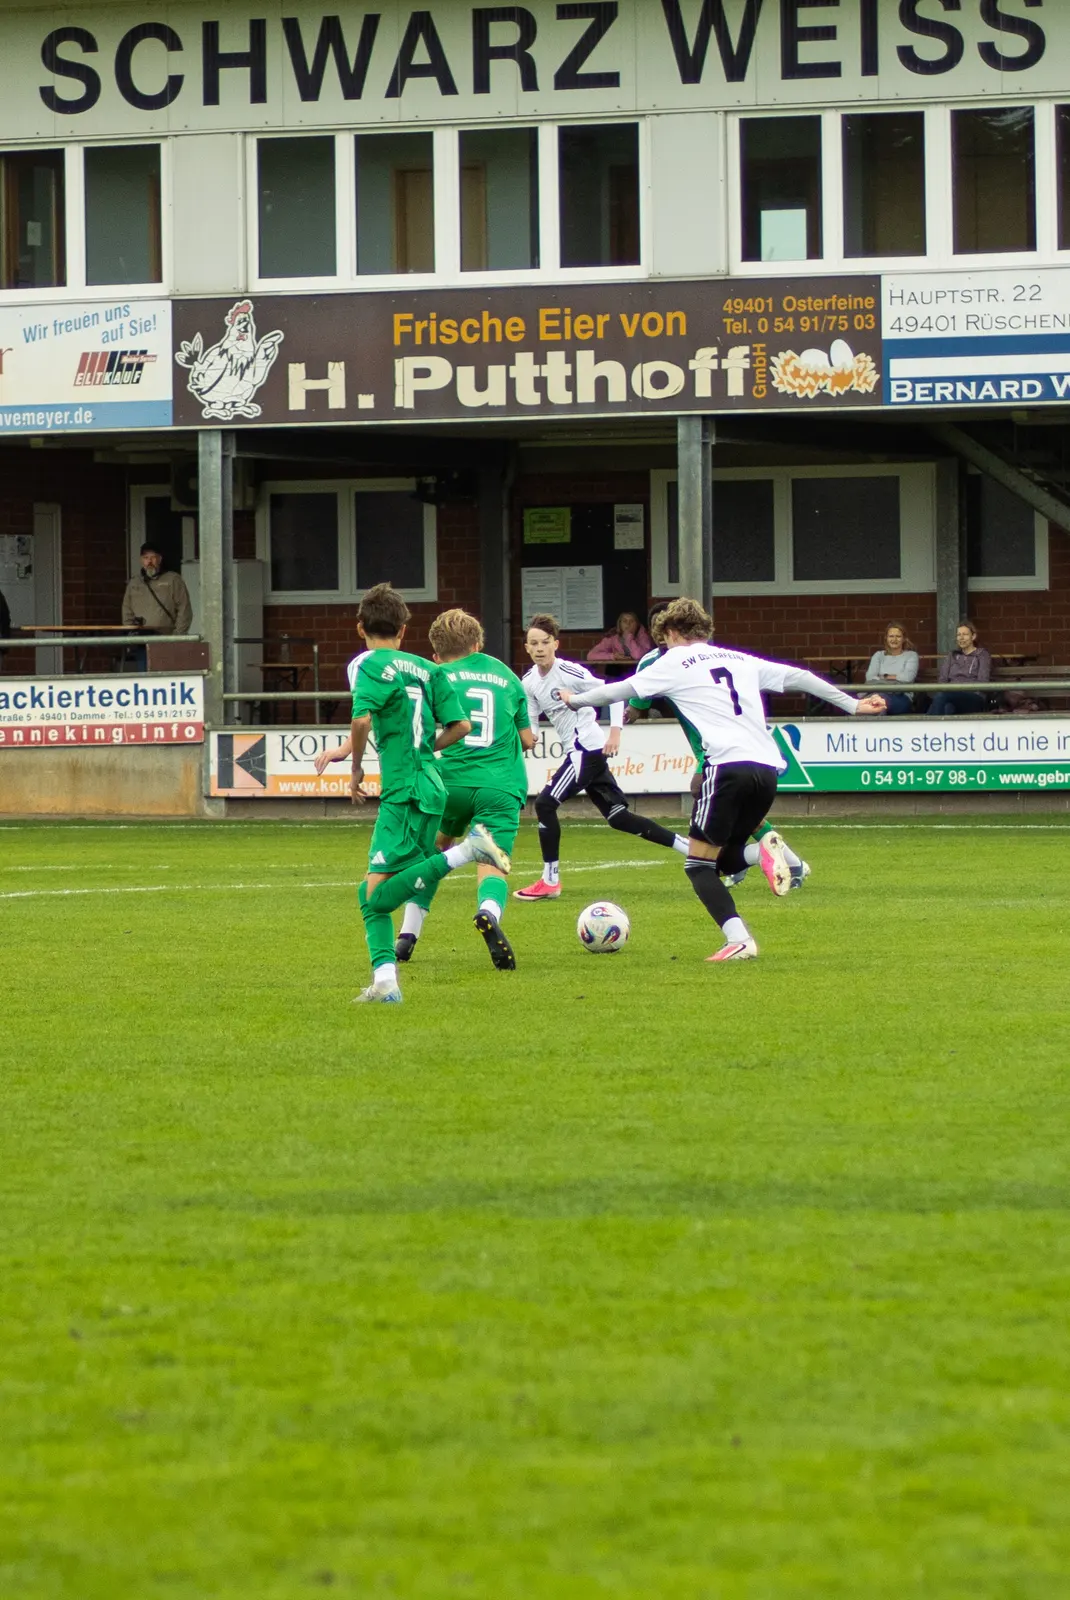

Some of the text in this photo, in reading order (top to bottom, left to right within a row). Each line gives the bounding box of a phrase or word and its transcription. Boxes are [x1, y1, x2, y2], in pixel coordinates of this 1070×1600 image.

[38, 0, 1046, 115] SCHWARZ WEISS
[722, 294, 875, 314] 49401 Osterfeine
[1012, 284, 1043, 302] 22
[23, 304, 130, 343] Wir freuen uns
[101, 314, 157, 344] auf Sie!
[393, 307, 687, 345] Frische Eier von
[722, 314, 876, 335] Tel. 0 54 91/75 03
[889, 313, 1070, 333] 49401 RÜSCHEN
[74, 370, 142, 386] ELTKAUF
[288, 345, 750, 411] H. Putthoff
[752, 343, 767, 399] GmbH
[681, 656, 697, 669] SW
[459, 671, 509, 688] BROCKDORF
[709, 667, 743, 716] 7
[26, 713, 32, 721] 5
[39, 712, 67, 721] 49401
[71, 711, 106, 721] Damme
[135, 710, 142, 719] 0
[144, 710, 155, 718] 54
[186, 710, 198, 718] 57
[405, 685, 424, 749] 7
[464, 687, 495, 748] 3
[826, 733, 858, 753] Mit
[865, 737, 903, 752] uns
[911, 732, 976, 752] stehst
[983, 732, 1009, 751] du
[1017, 731, 1049, 751] nie
[652, 752, 697, 775] Trup
[861, 770, 870, 785] 0
[875, 770, 893, 785] 54
